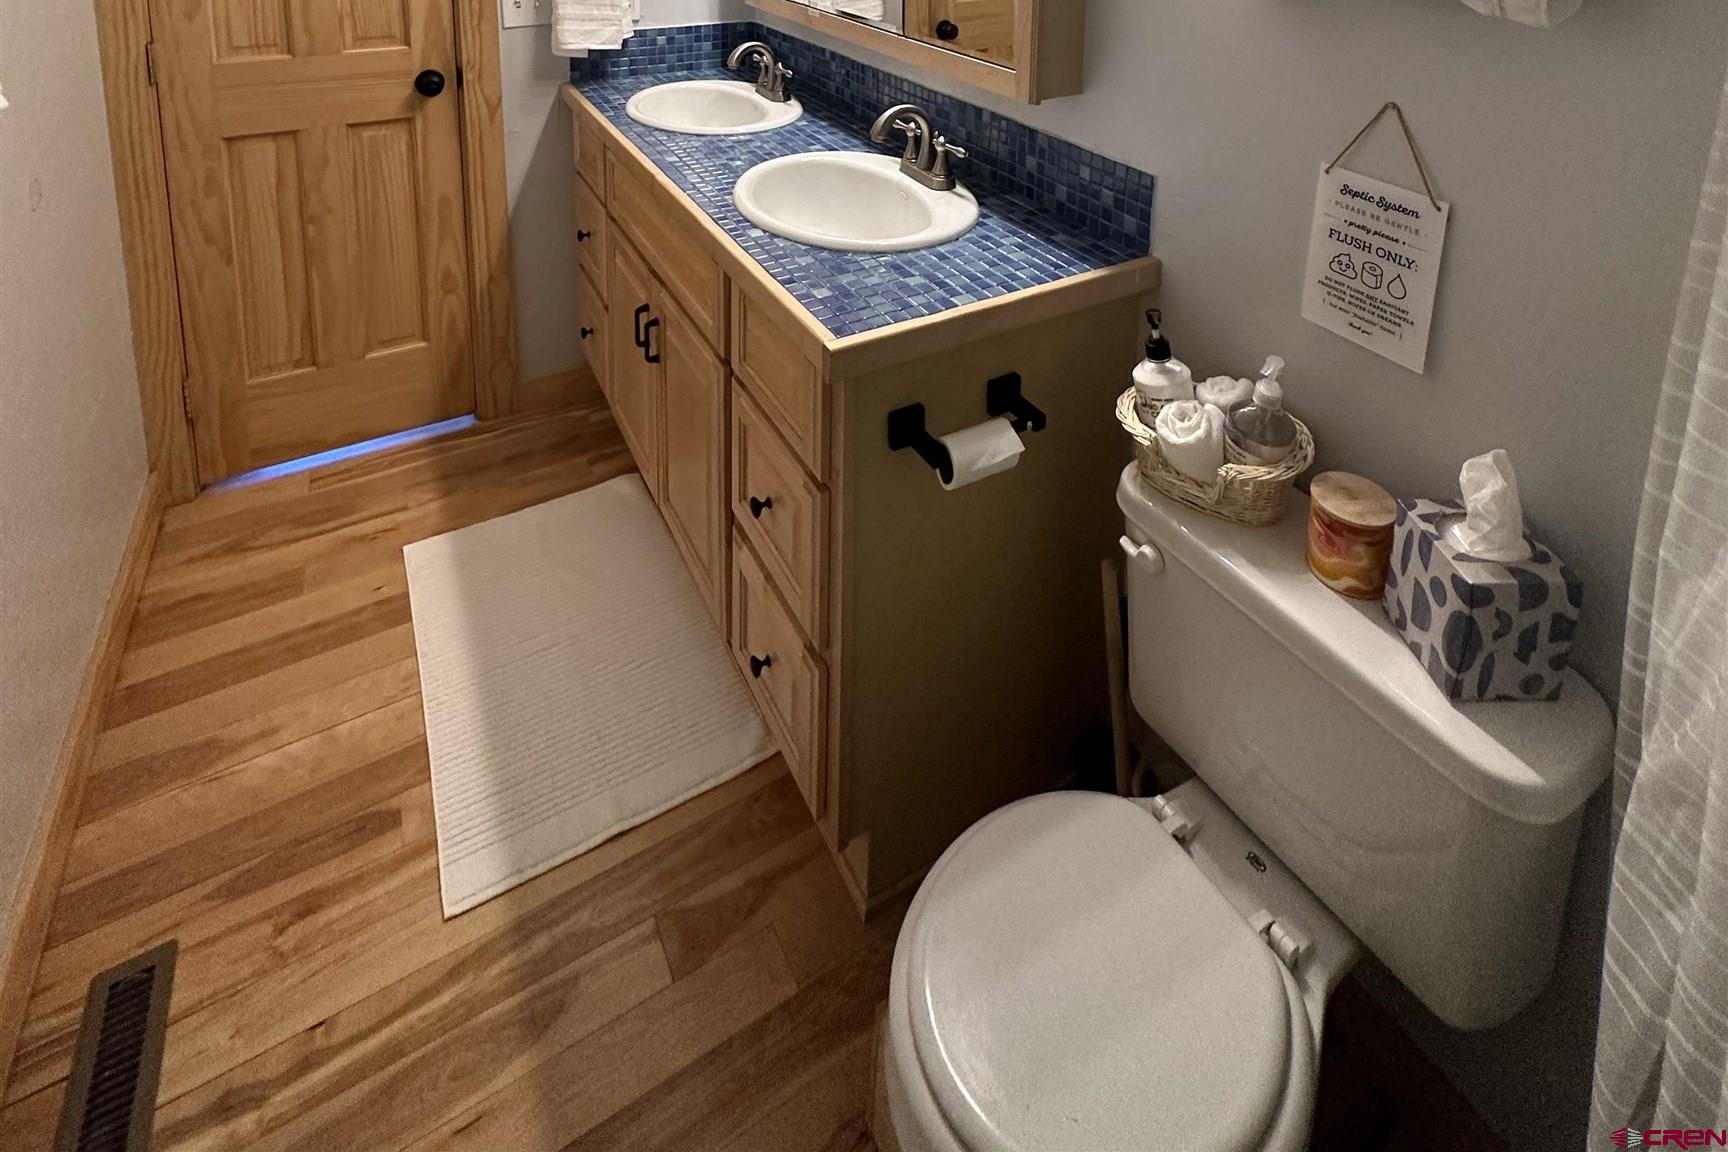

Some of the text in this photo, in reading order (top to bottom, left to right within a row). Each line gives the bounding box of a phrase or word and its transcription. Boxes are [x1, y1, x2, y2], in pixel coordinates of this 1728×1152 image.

[1335, 199, 1367, 217] PLEASE
[1340, 183, 1421, 219] Septic System
[1328, 228, 1373, 254] FLUSH
[1347, 221, 1400, 244] pretty please
